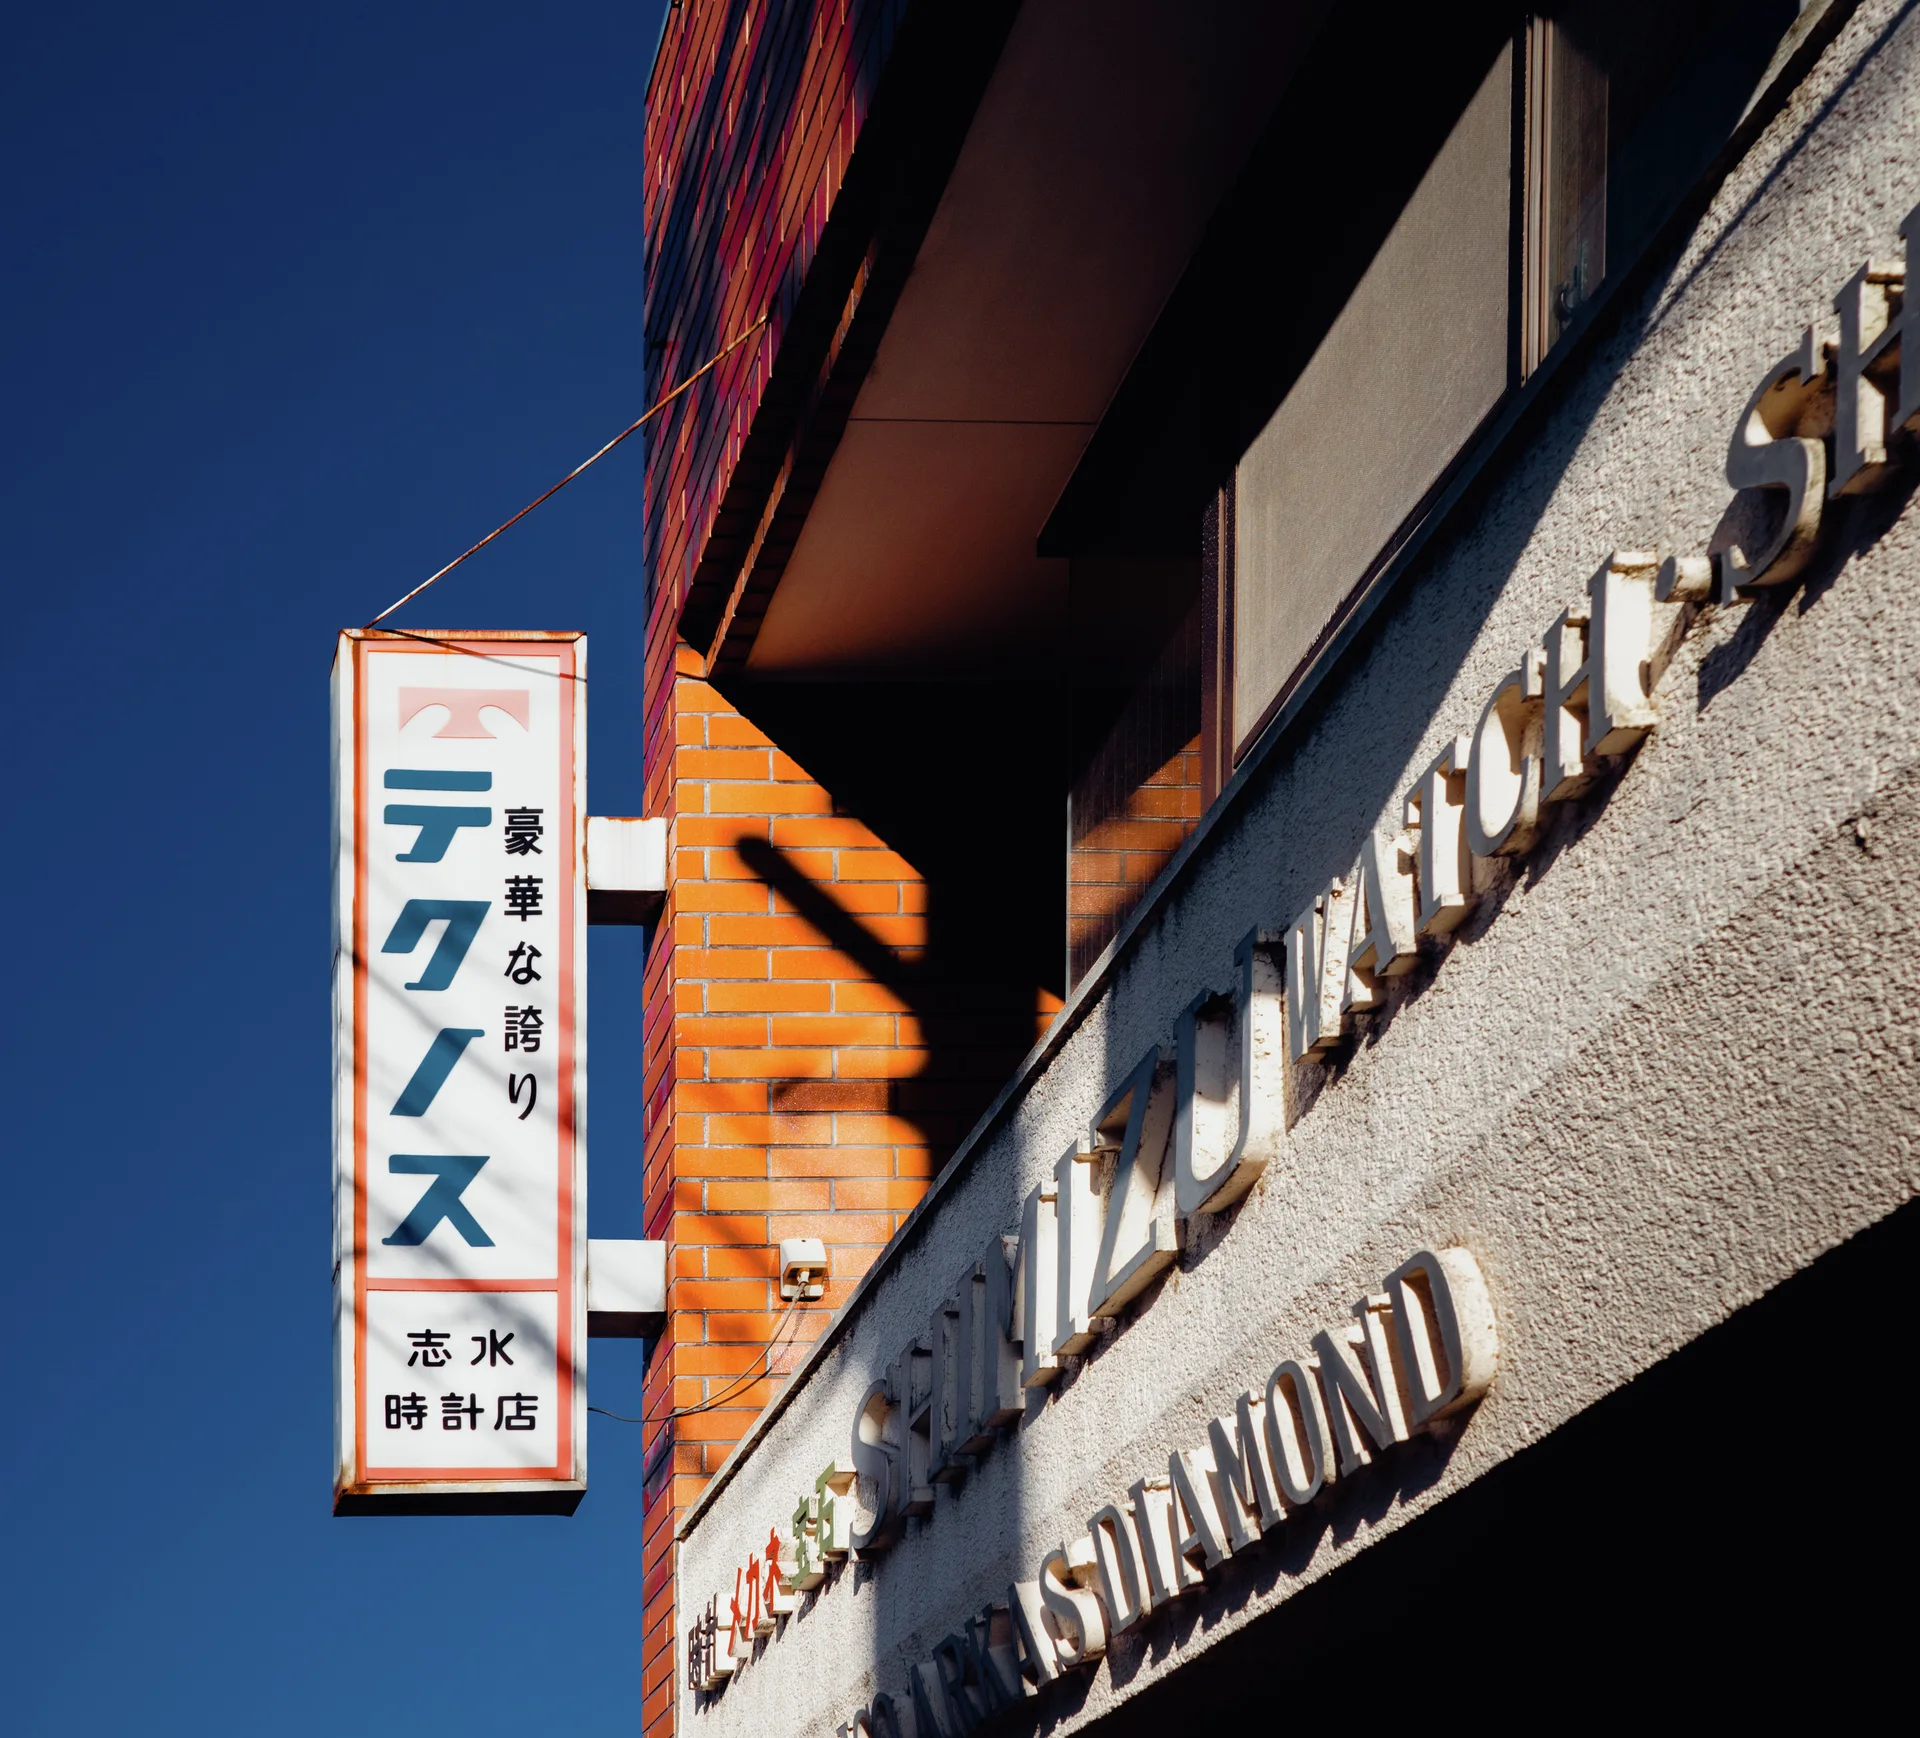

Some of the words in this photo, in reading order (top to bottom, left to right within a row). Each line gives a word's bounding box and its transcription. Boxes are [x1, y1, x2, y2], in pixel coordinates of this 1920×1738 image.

[381, 769, 495, 1248] テクノス
[503, 806, 544, 1121] 豪華な誇り
[851, 924, 1265, 1562] SHIMIZU
[1284, 550, 1622, 1063] WATCH
[384, 1391, 539, 1431] 時計店
[406, 1328, 515, 1368] 志水
[1086, 1250, 1465, 1638] DIAMOND
